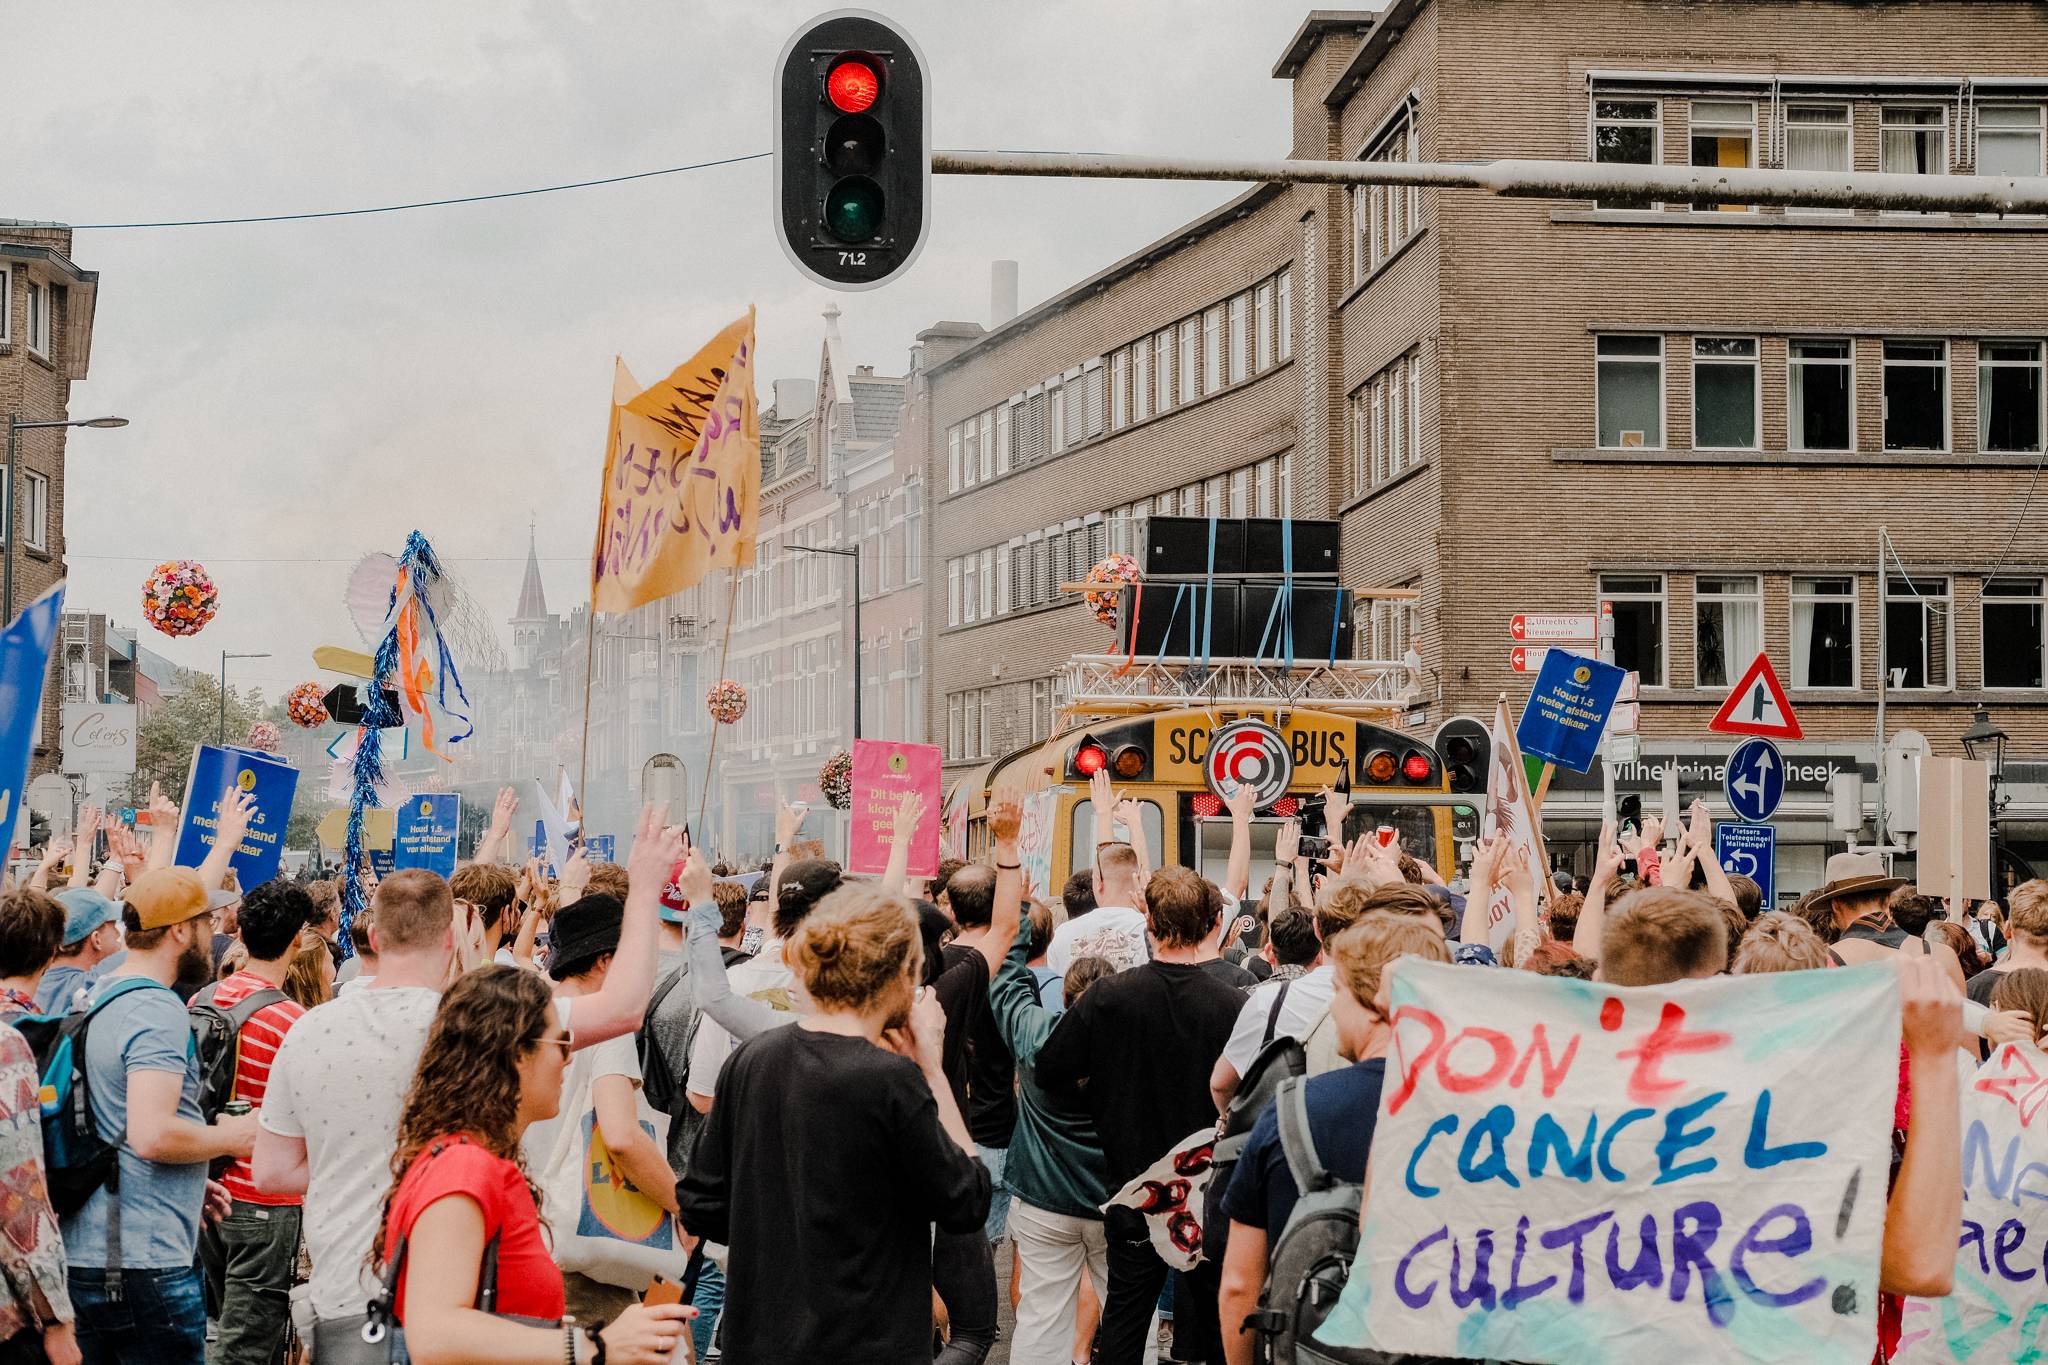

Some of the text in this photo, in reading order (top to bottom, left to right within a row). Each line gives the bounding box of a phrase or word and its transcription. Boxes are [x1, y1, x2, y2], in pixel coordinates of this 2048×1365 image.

[838, 251, 867, 266] 71.2
[1536, 617, 1566, 625] Utrecht
[1568, 617, 1579, 625] CS
[1526, 628, 1573, 637] Nieuwegein
[1552, 685, 1579, 704] Houd
[1580, 696, 1595, 707] 1.5
[1536, 694, 1566, 711] meter
[1565, 705, 1602, 723] afstand
[1541, 708, 1590, 732] van elkaar
[1292, 730, 1345, 768] BUS
[1784, 760, 1841, 782] heek
[192, 814, 277, 844] met stand
[1732, 827, 1761, 836] Fietsers
[200, 833, 217, 846] va
[1721, 833, 1771, 844] Tolsteegsingel
[1726, 841, 1766, 850] Maliesingel
